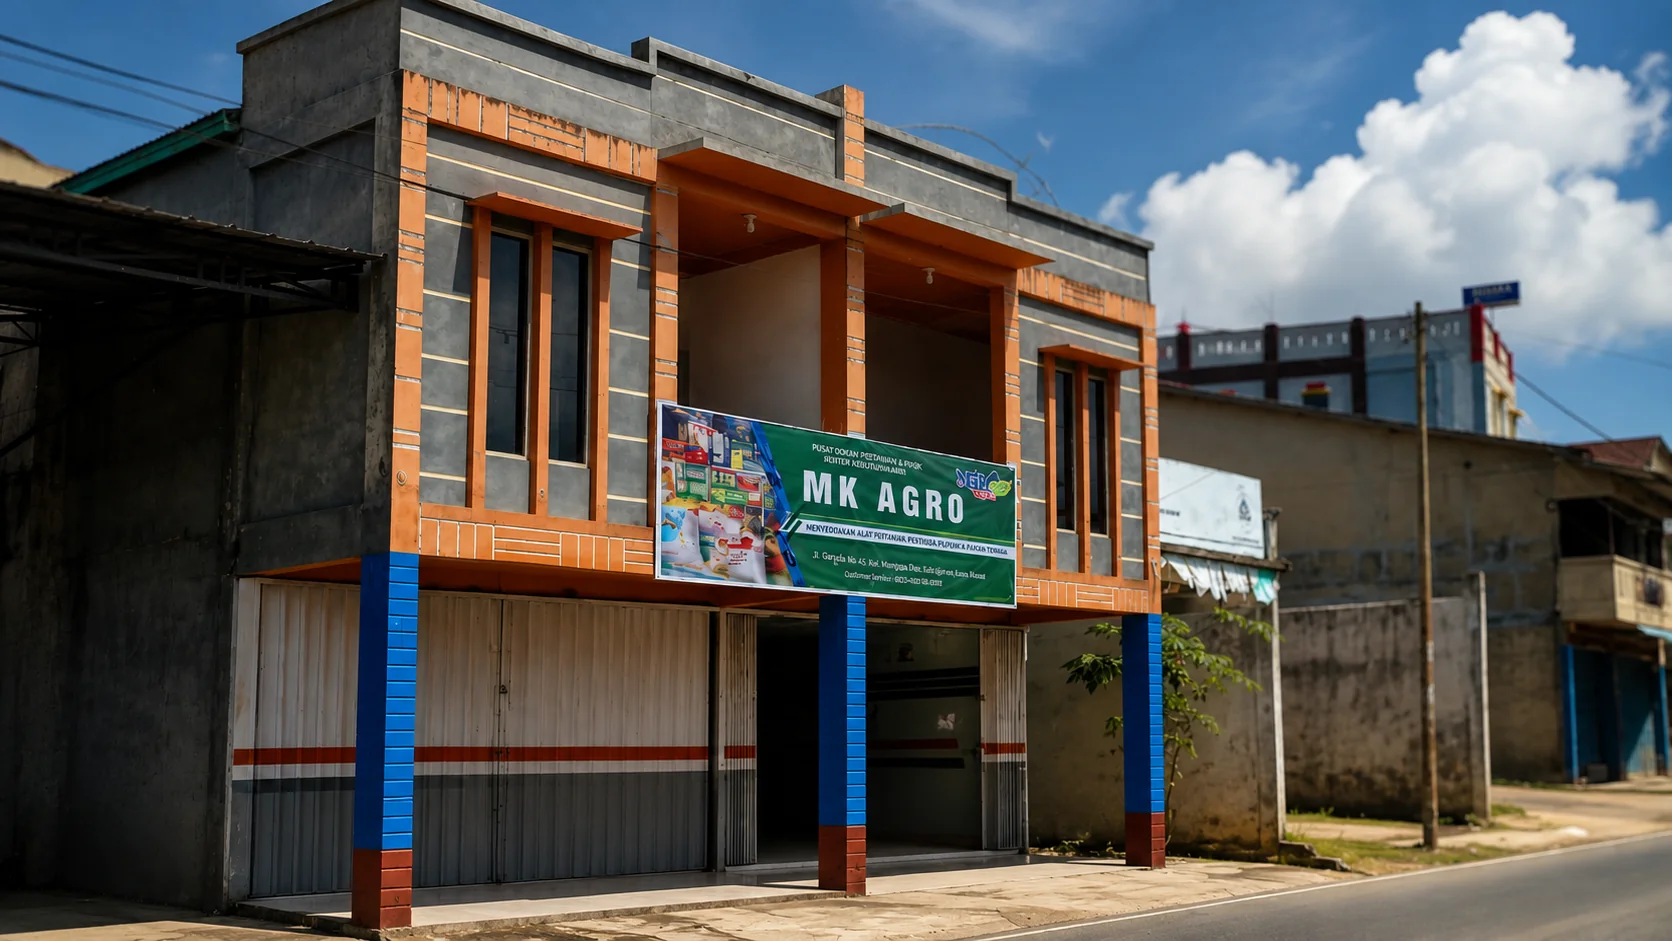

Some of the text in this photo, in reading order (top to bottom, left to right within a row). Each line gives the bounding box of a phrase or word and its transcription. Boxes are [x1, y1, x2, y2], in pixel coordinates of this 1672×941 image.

[812, 443, 834, 454] PUSAT
[803, 469, 859, 509] MK
[877, 481, 964, 524] AGRO
